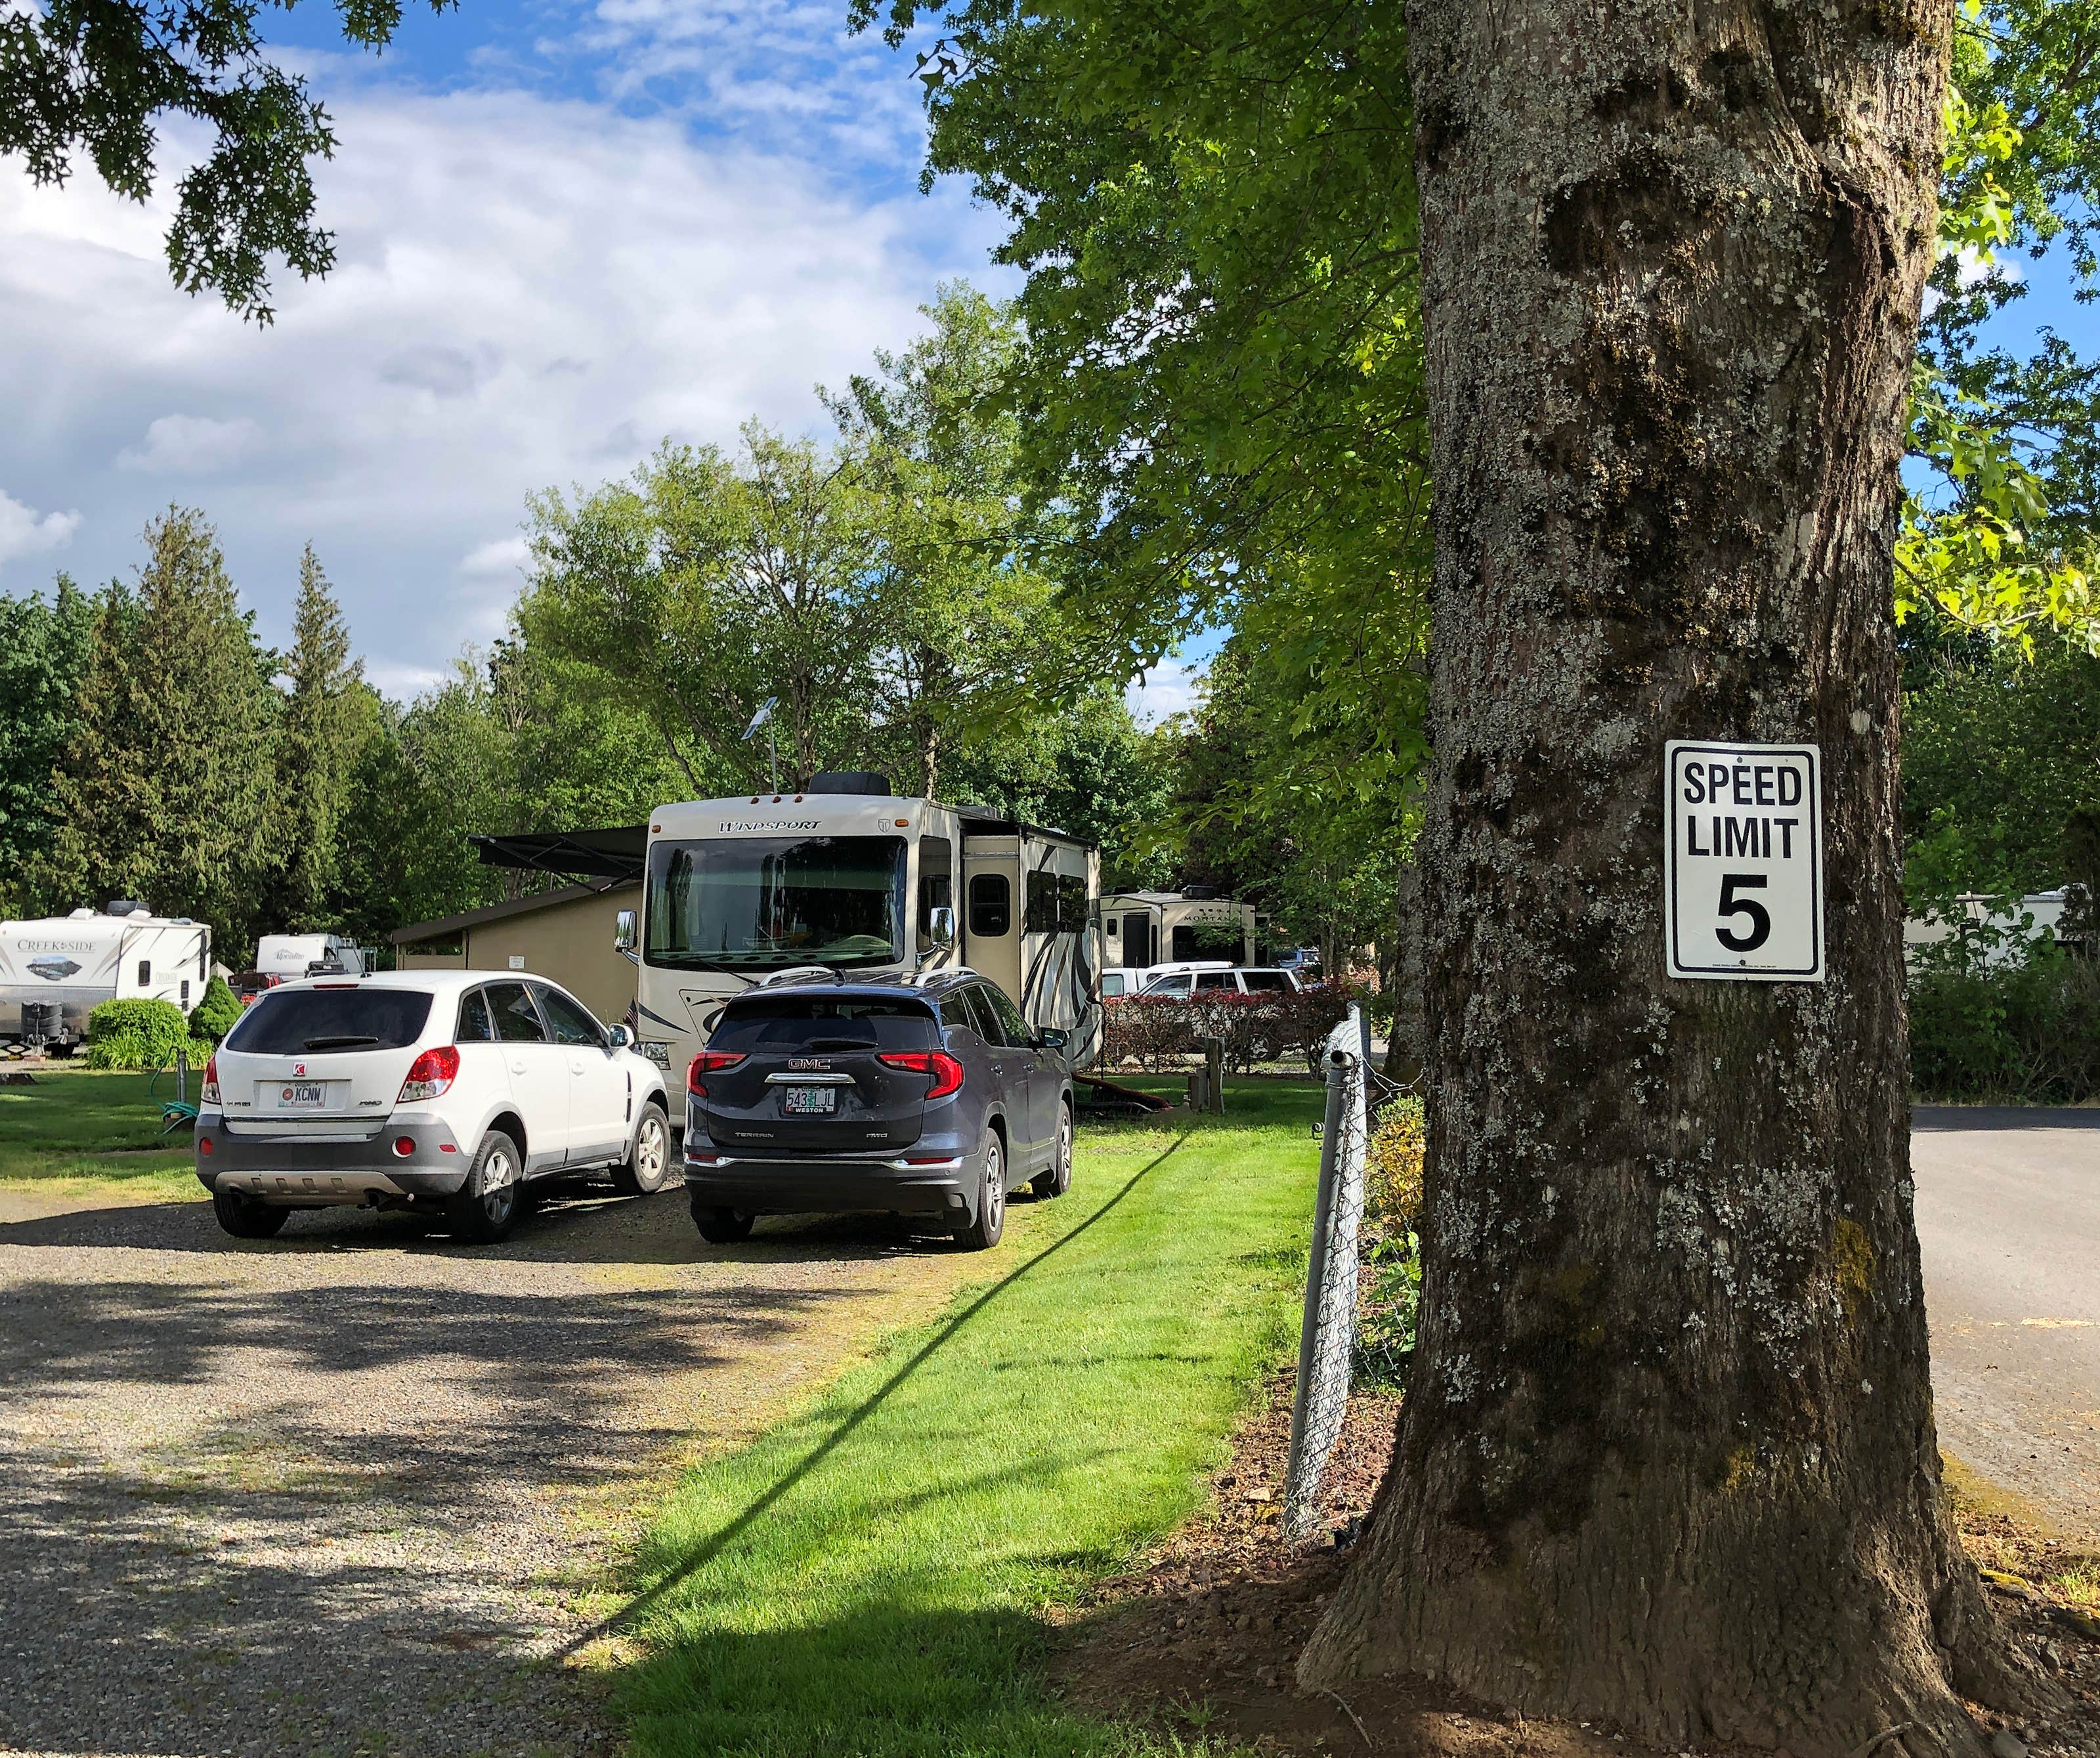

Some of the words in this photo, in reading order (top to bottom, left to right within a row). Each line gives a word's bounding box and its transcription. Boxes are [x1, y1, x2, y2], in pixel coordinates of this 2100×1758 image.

[1684, 761, 1802, 806] SPEED
[719, 820, 822, 832] WINDSPORT
[1688, 815, 1799, 859] LIMIT
[1715, 874, 1771, 953] 5
[788, 1058, 831, 1069] GMC
[788, 1092, 807, 1107] 543
[814, 1092, 834, 1107] LJL
